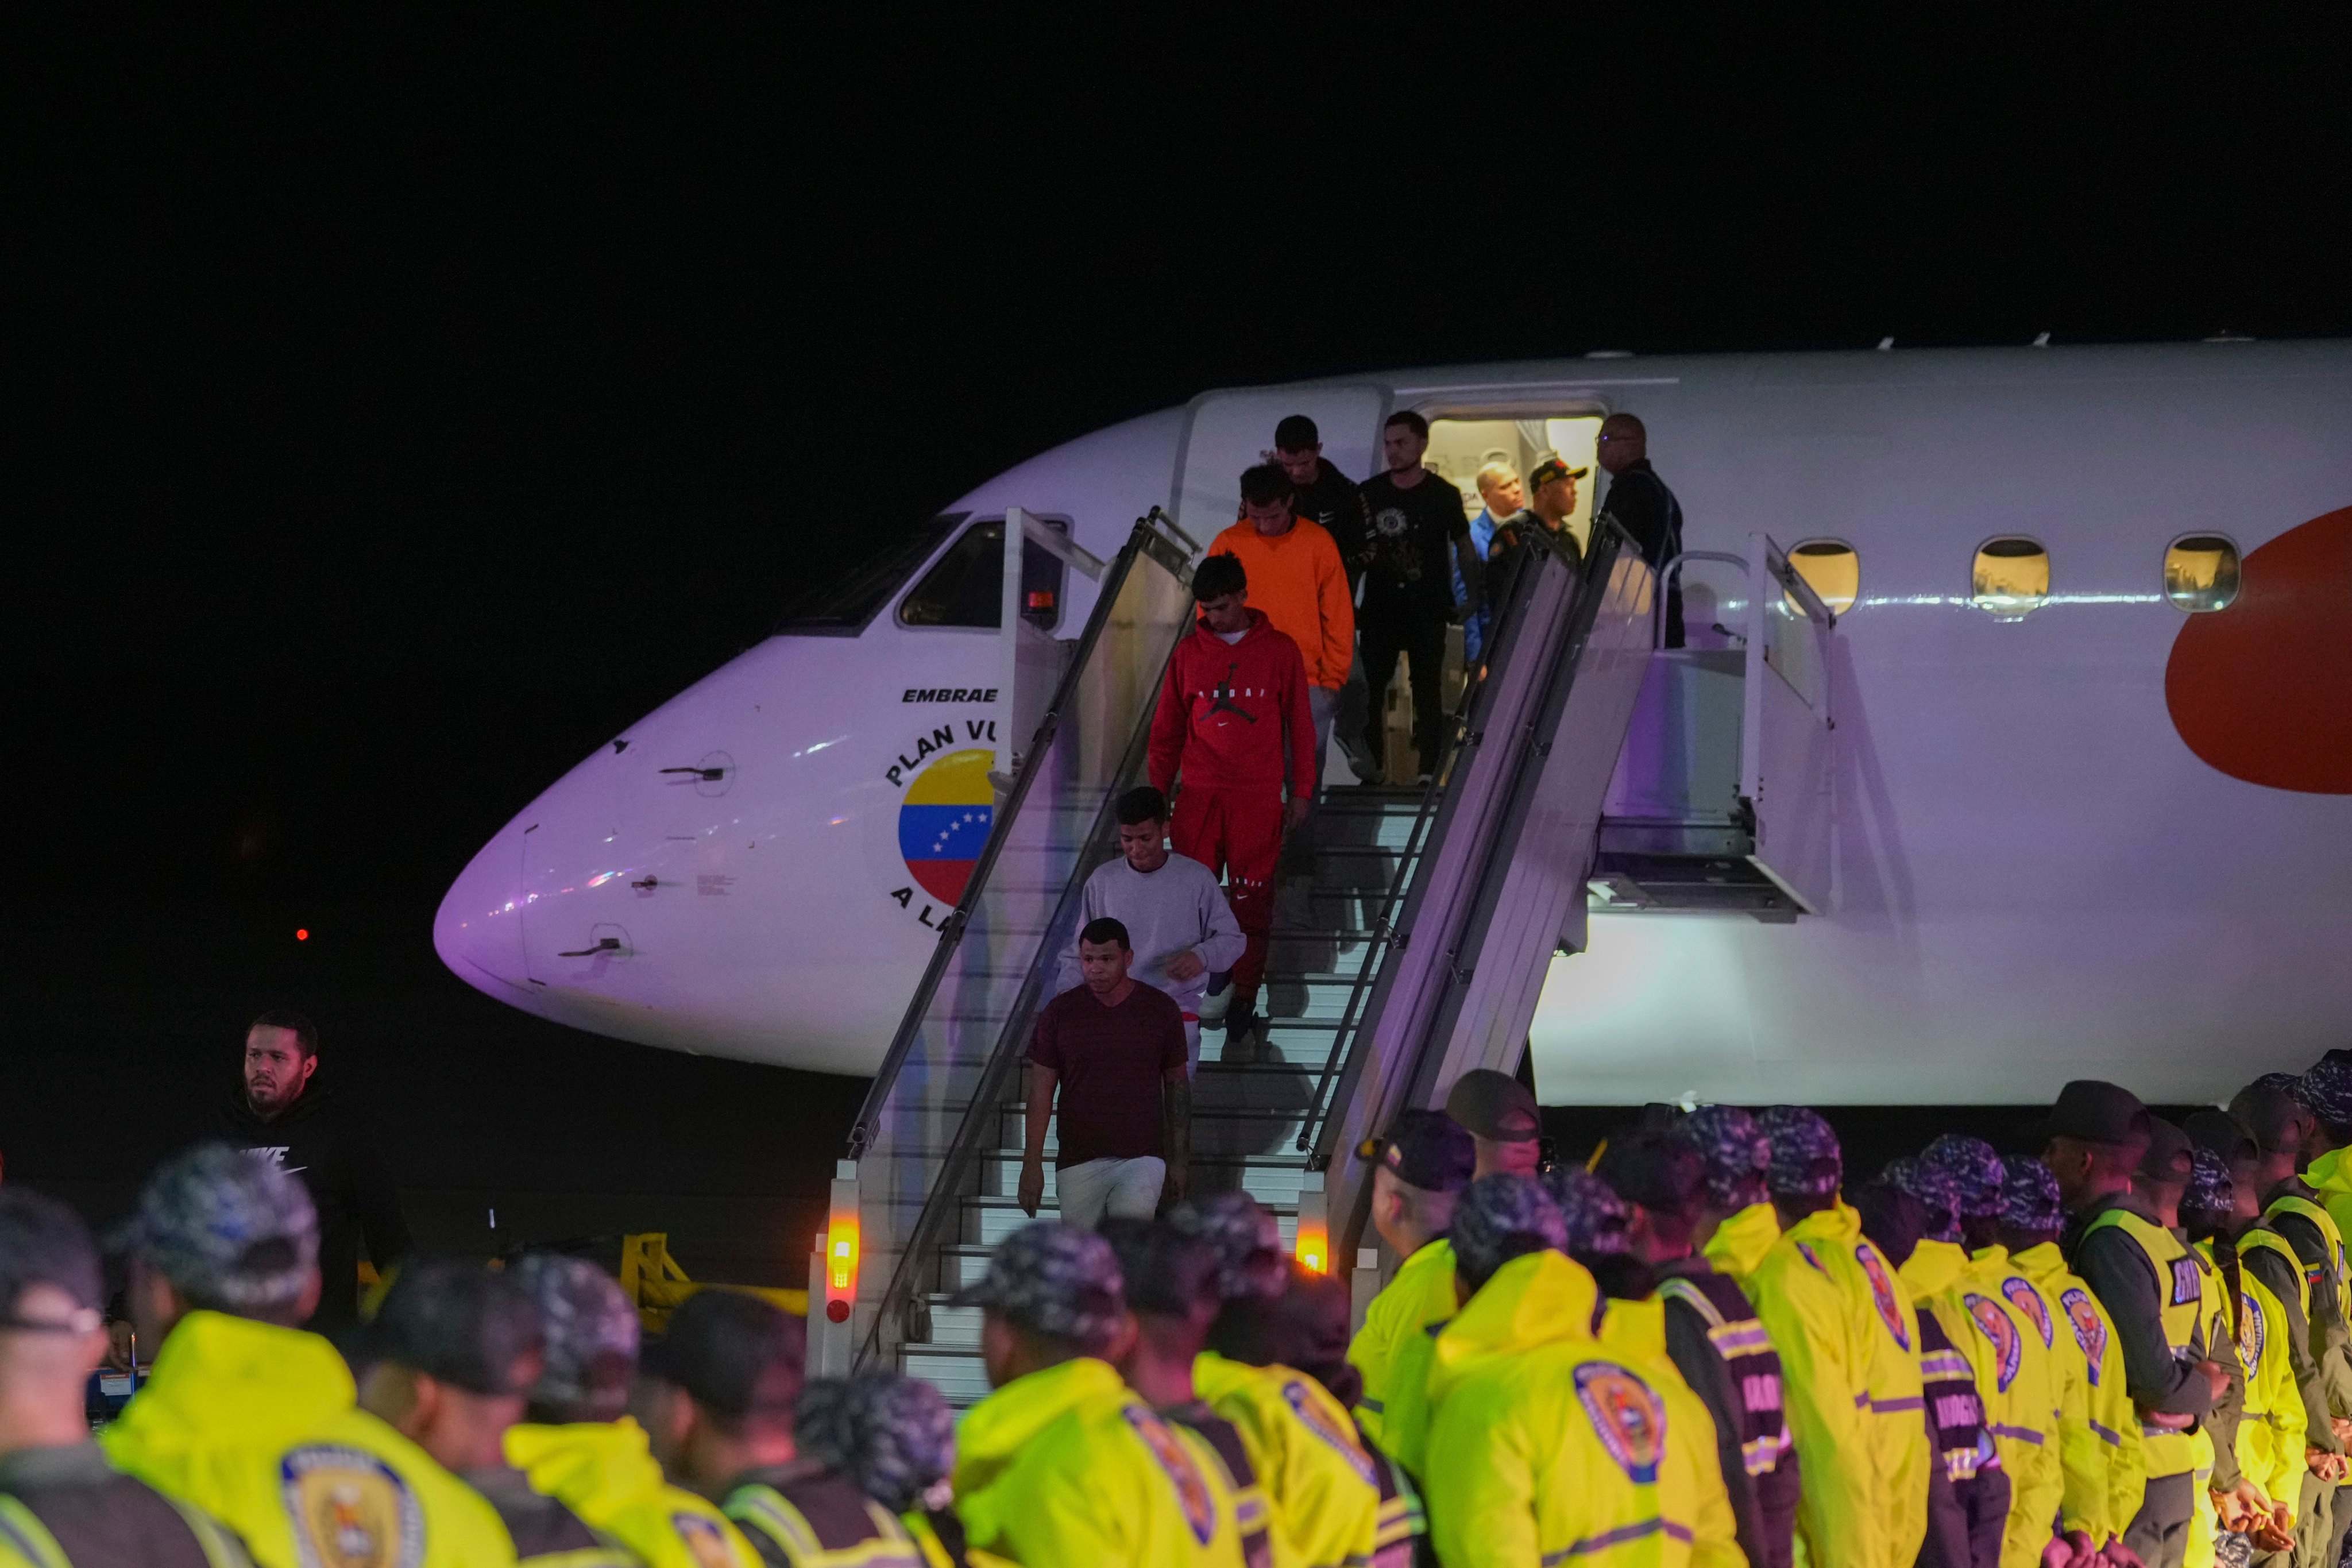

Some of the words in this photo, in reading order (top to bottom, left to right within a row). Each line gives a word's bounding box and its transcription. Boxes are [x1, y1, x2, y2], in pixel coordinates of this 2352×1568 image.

[902, 688, 998, 703] EMBRAE
[885, 724, 955, 788] PLAN
[890, 886, 914, 909] A
